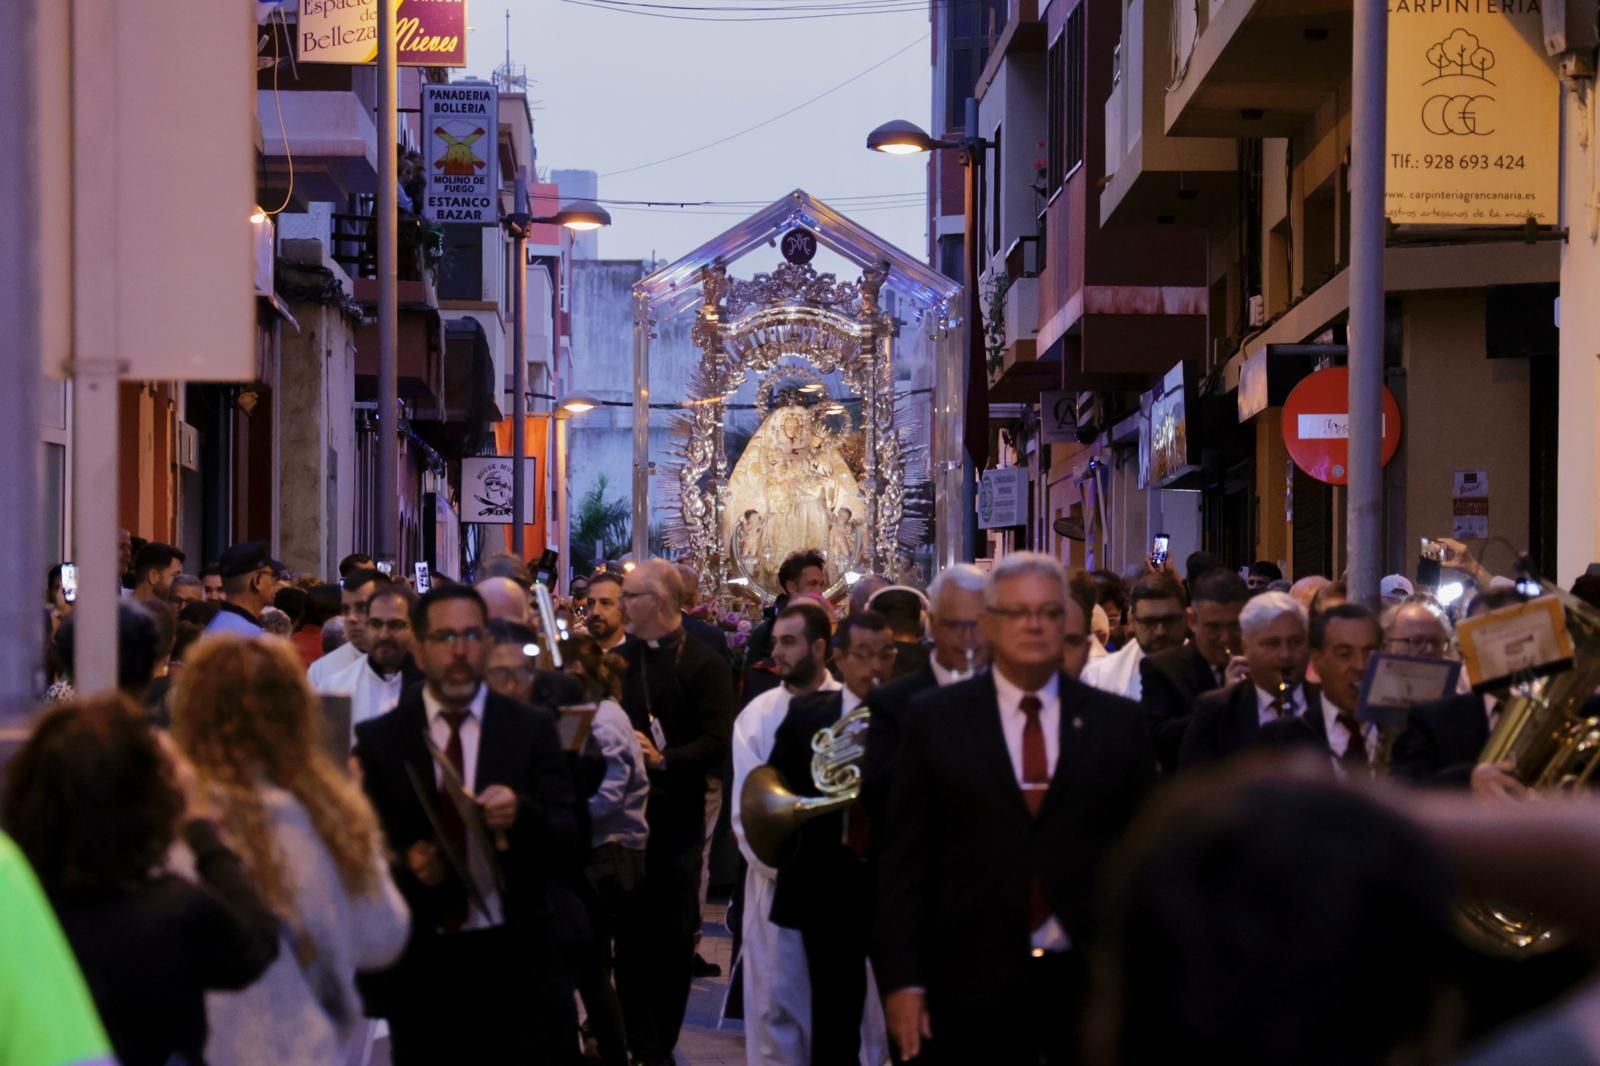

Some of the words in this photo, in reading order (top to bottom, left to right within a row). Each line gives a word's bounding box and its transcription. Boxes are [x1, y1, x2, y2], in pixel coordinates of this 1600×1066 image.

[1388, 0, 1541, 13] ARPINTERIA
[303, 25, 376, 53] Belleza
[430, 90, 491, 101] PANADERIA
[434, 102, 486, 113] BOLLERIA
[1391, 154, 1419, 169] Tlf.:
[1424, 154, 1454, 169] 928
[1459, 155, 1489, 169] 693
[1494, 155, 1525, 170] 424
[434, 175, 471, 185] MOLINO
[473, 175, 485, 185] DE
[444, 184, 475, 193] FUEGO
[1410, 190, 1536, 203] carpinteriagrancanaria.es
[428, 197, 490, 208] ESTANCO
[436, 209, 482, 220] BAZAR
